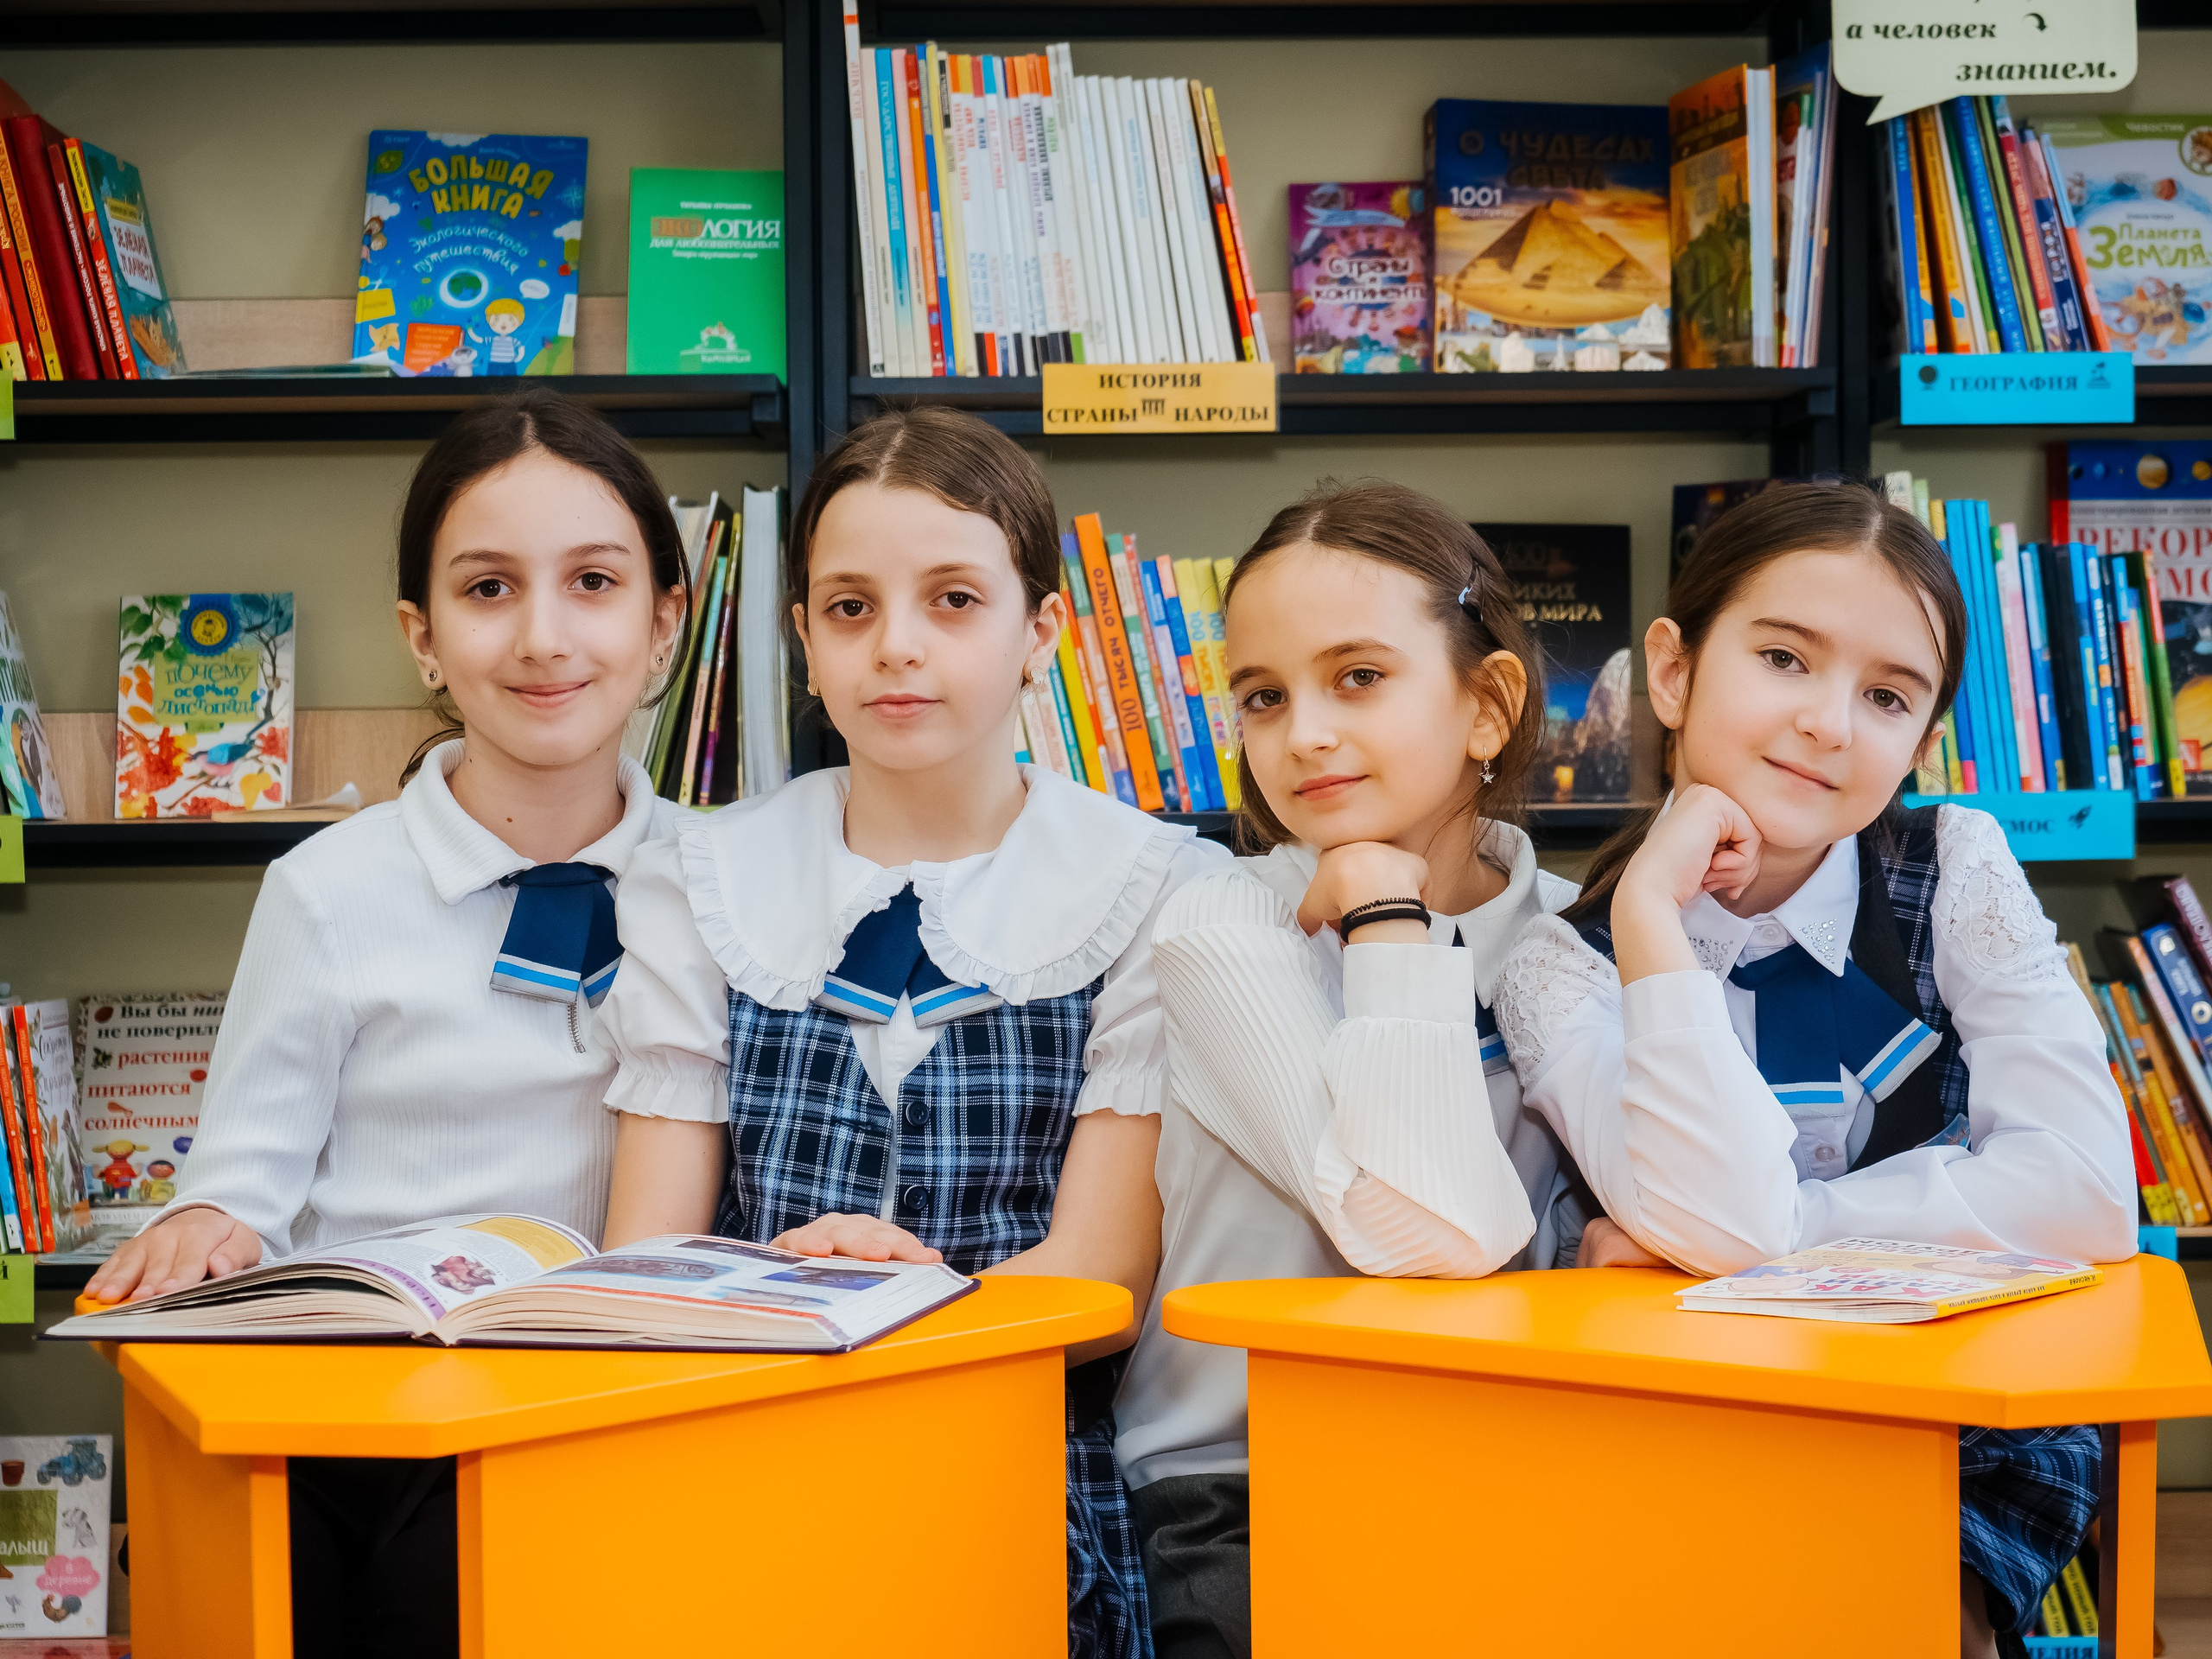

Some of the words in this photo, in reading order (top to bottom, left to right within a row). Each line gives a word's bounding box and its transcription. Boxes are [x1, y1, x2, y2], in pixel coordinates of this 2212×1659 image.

[1846, 23, 1863, 39] а
[1873, 22, 1997, 39] человек
[1955, 60, 2117, 82] знанием.
[409, 155, 554, 199] БОЛЬШАЯ
[431, 184, 524, 219] КНИГА
[1449, 185, 1503, 207] 1001
[2119, 223, 2201, 241] Планета
[2085, 226, 2207, 270] Земля
[1328, 257, 1410, 276] Страны
[80, 267, 93, 296] РОССИИ
[87, 296, 99, 319] КНИГА
[93, 319, 107, 351] КРАСНАЯ
[109, 309, 129, 361] ПЛАНЕТА
[1099, 373, 1202, 389] ИСТОРИЯ
[1950, 376, 2078, 392] ГЕОГРАФИЯ
[1047, 408, 1138, 423] СТРАНЫ
[1174, 407, 1268, 423] НАРОДЫ
[1093, 567, 1116, 627] ОТЧЕГО
[1540, 604, 1602, 621] МИРА
[1189, 611, 1205, 642] 100
[1109, 637, 1129, 690] ТЫСЯЧ
[166, 664, 254, 685] почему
[174, 683, 238, 698] осенью
[1120, 698, 1141, 733] 100
[121, 1006, 150, 1019] Вы
[156, 1003, 187, 1017] бы
[98, 1028, 121, 1039] не
[118, 1052, 209, 1070] растения
[87, 1084, 190, 1098] питаются
[0, 1540, 48, 1556] алыш
